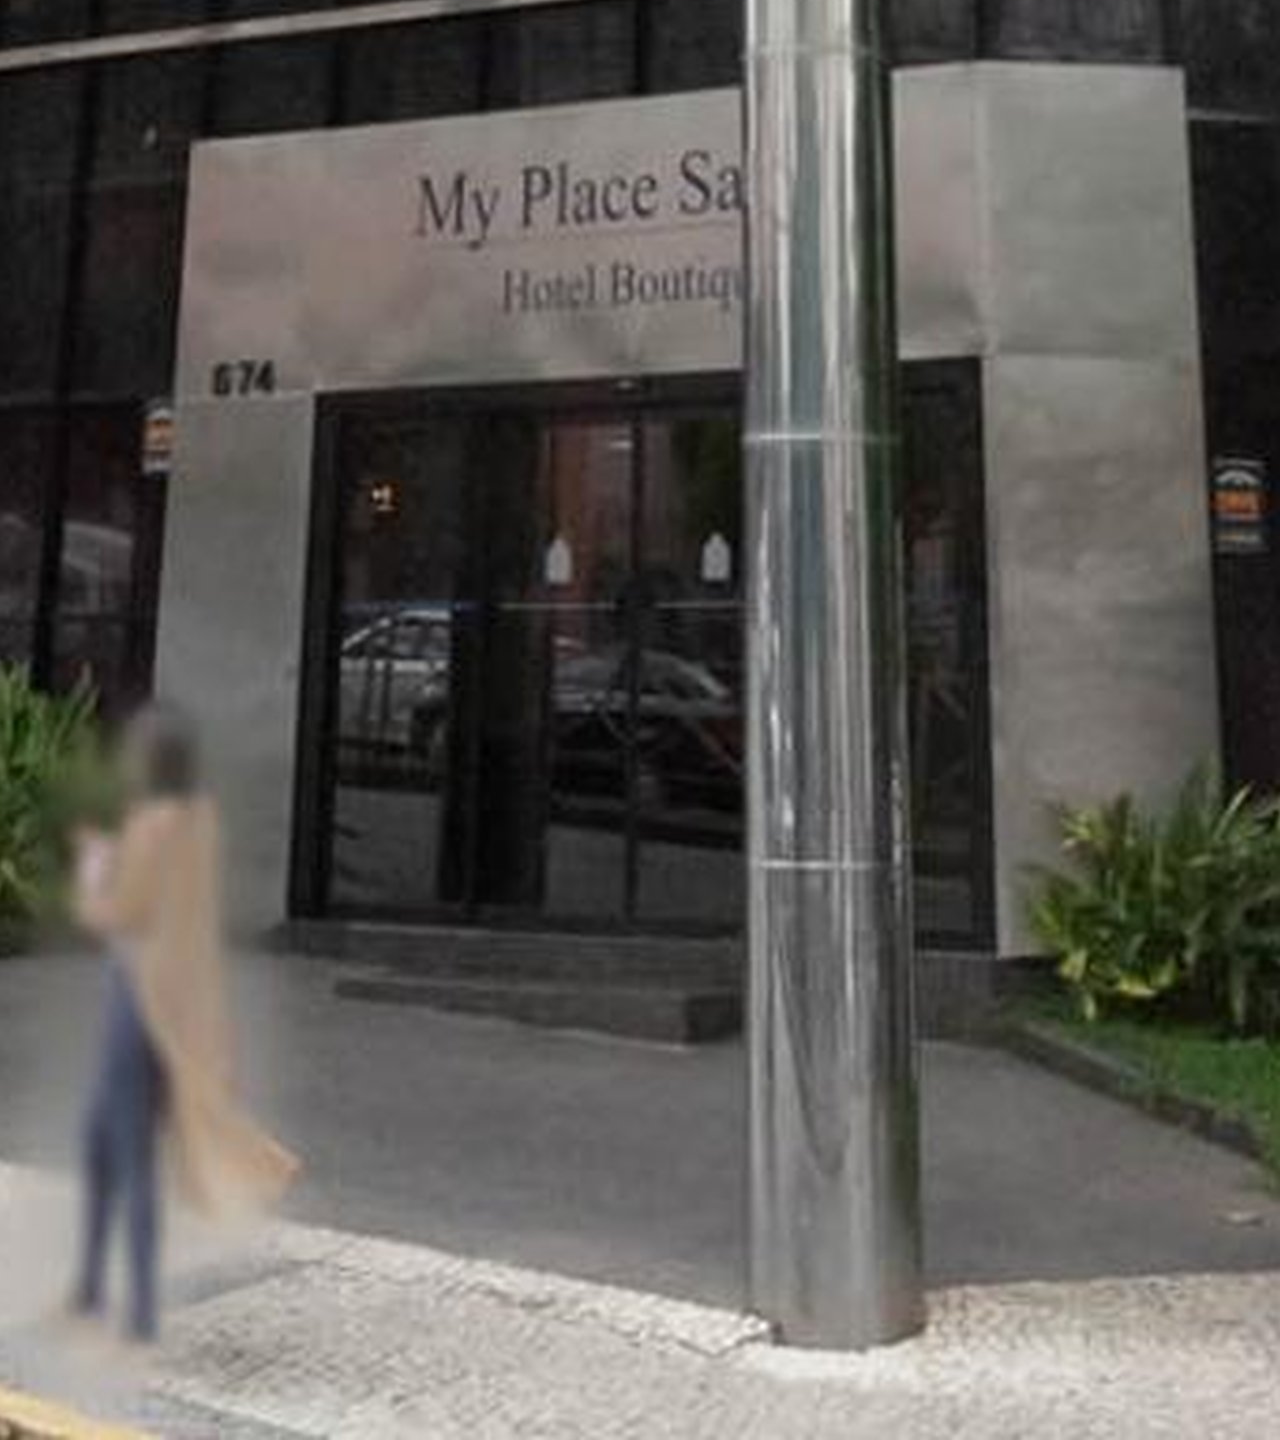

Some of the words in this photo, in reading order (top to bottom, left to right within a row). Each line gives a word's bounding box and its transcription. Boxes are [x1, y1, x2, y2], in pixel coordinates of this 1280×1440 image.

[416, 171, 501, 251] My
[522, 162, 658, 227] Place
[503, 263, 597, 313] Hotel
[213, 360, 276, 397] 674
